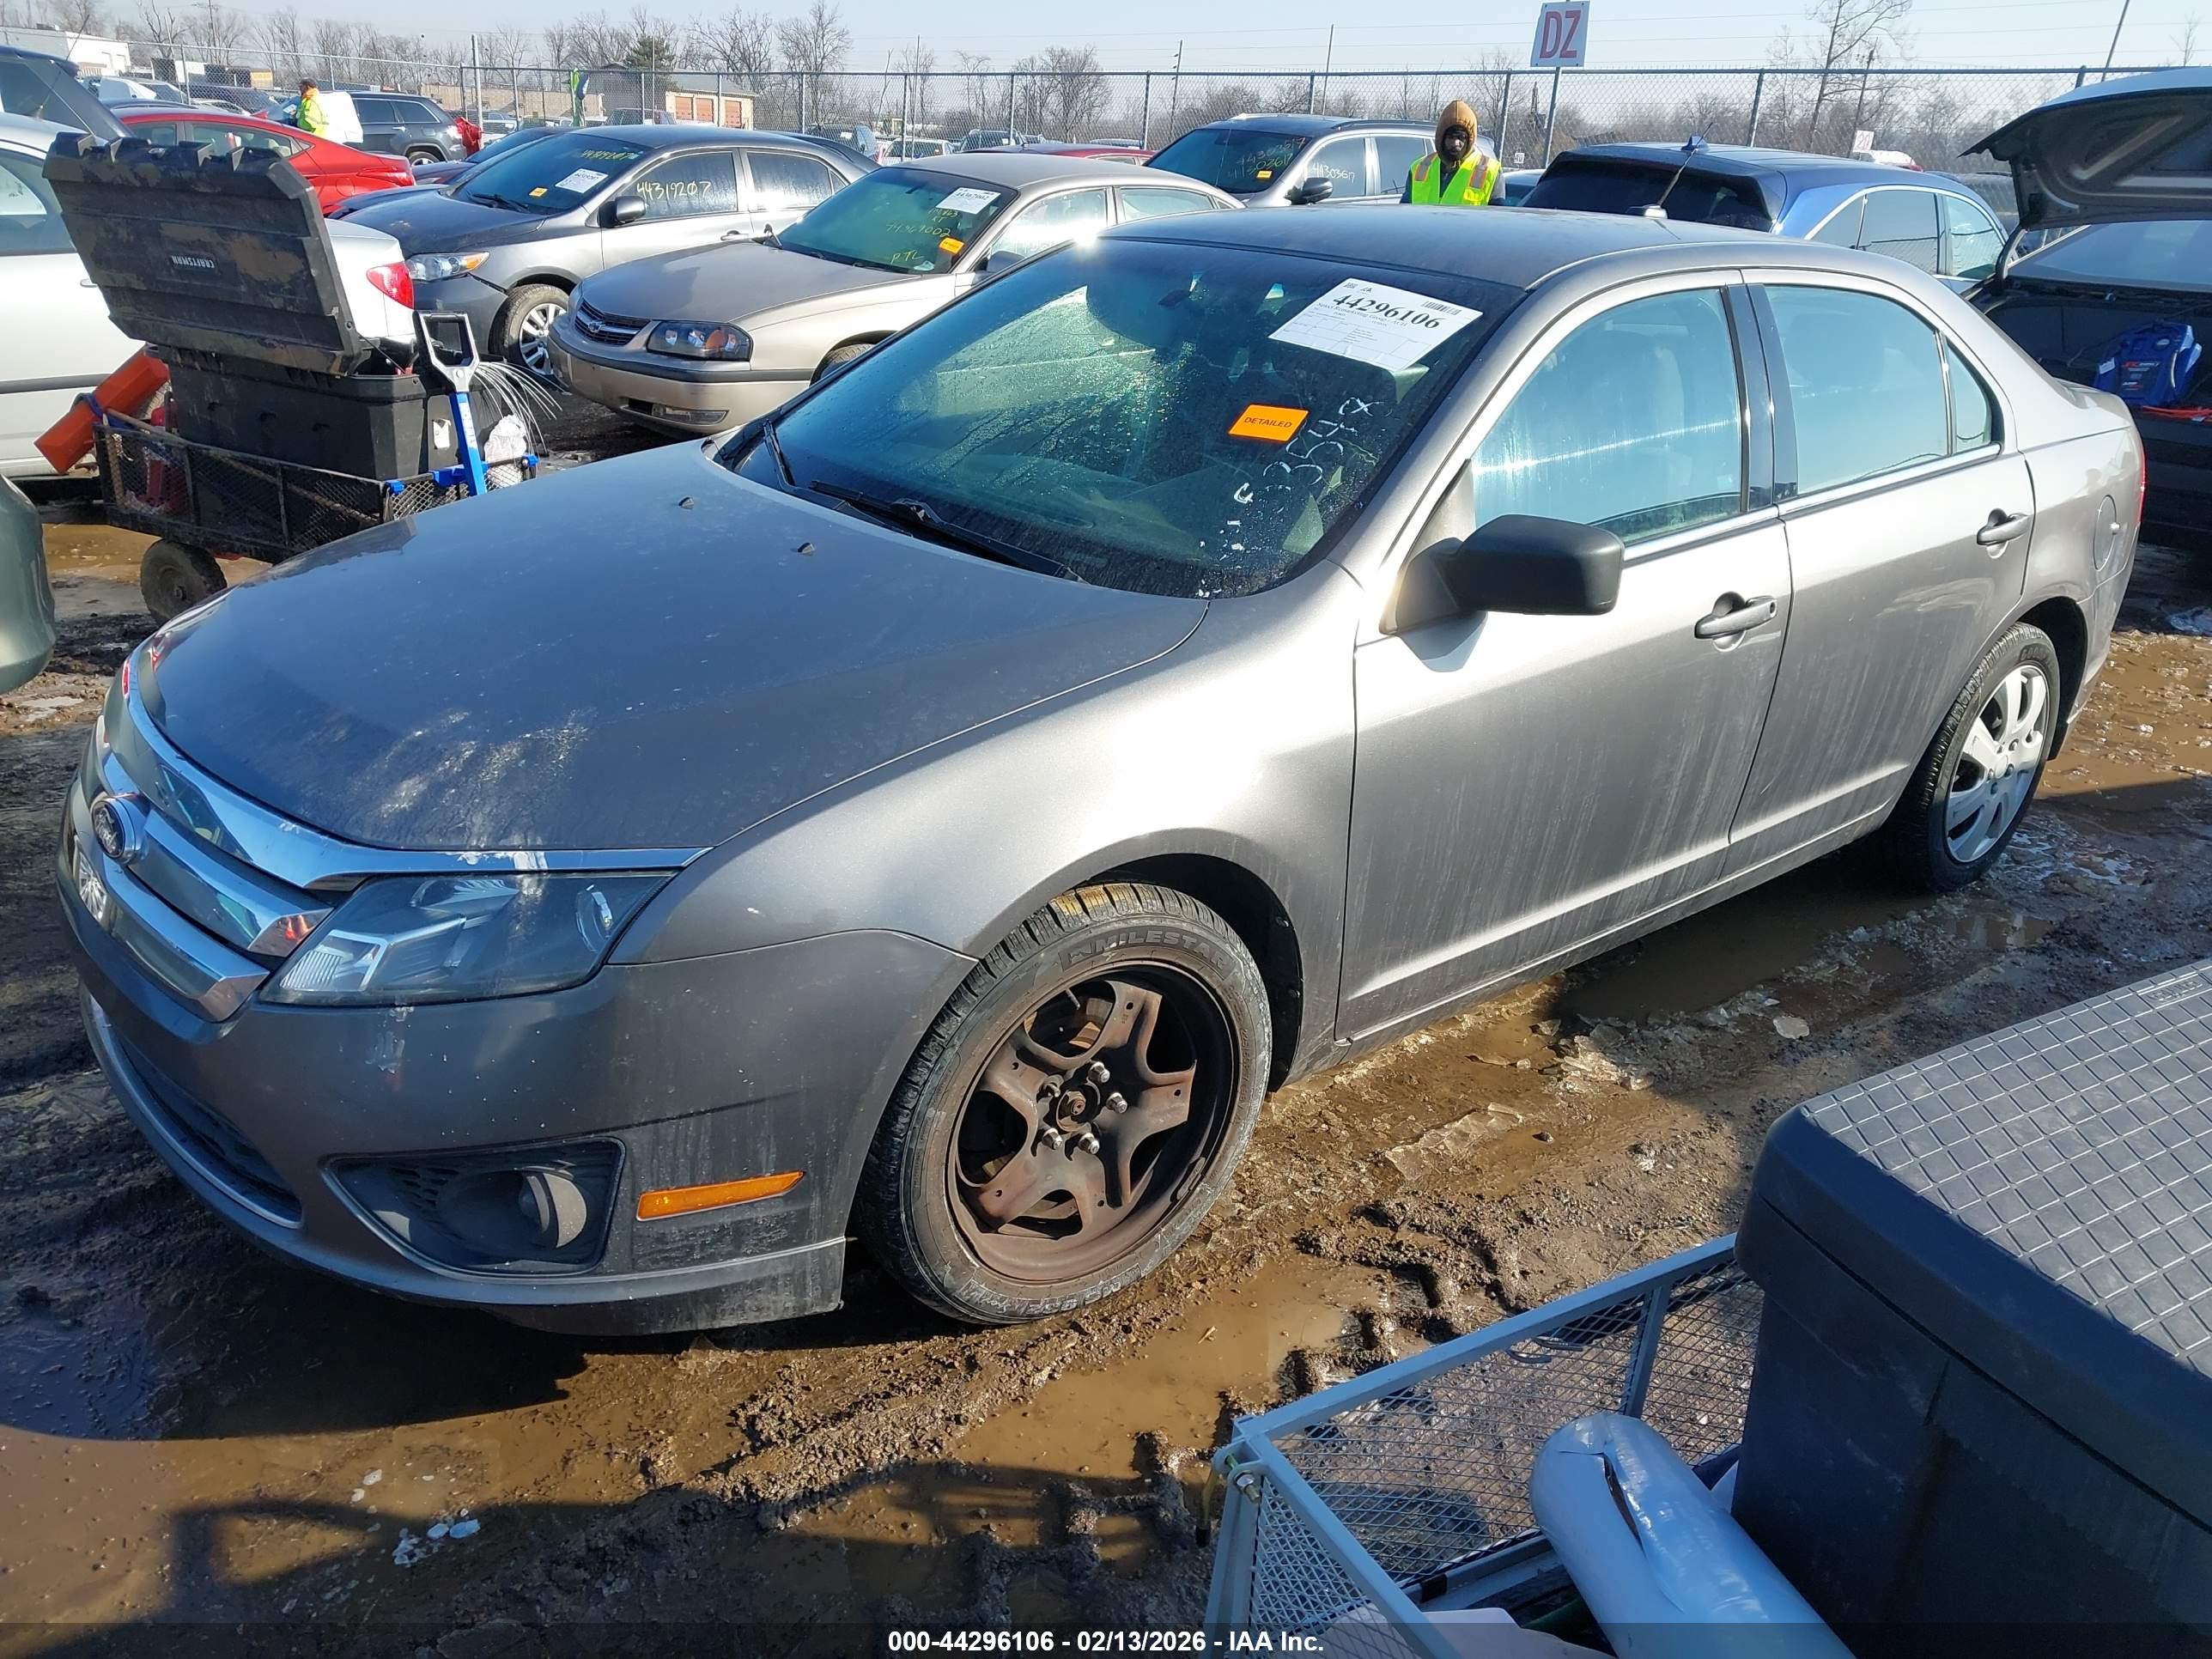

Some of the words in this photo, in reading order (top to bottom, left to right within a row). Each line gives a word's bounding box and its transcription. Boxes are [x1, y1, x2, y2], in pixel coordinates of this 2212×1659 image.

[1540, 10, 1581, 58] DZ
[636, 180, 711, 200] 44319207
[171, 255, 215, 269] CRAFTSMAN
[1333, 295, 1445, 329] 44296106
[1244, 416, 1292, 428] DETAILED
[1094, 930, 1226, 970] MILESTAR
